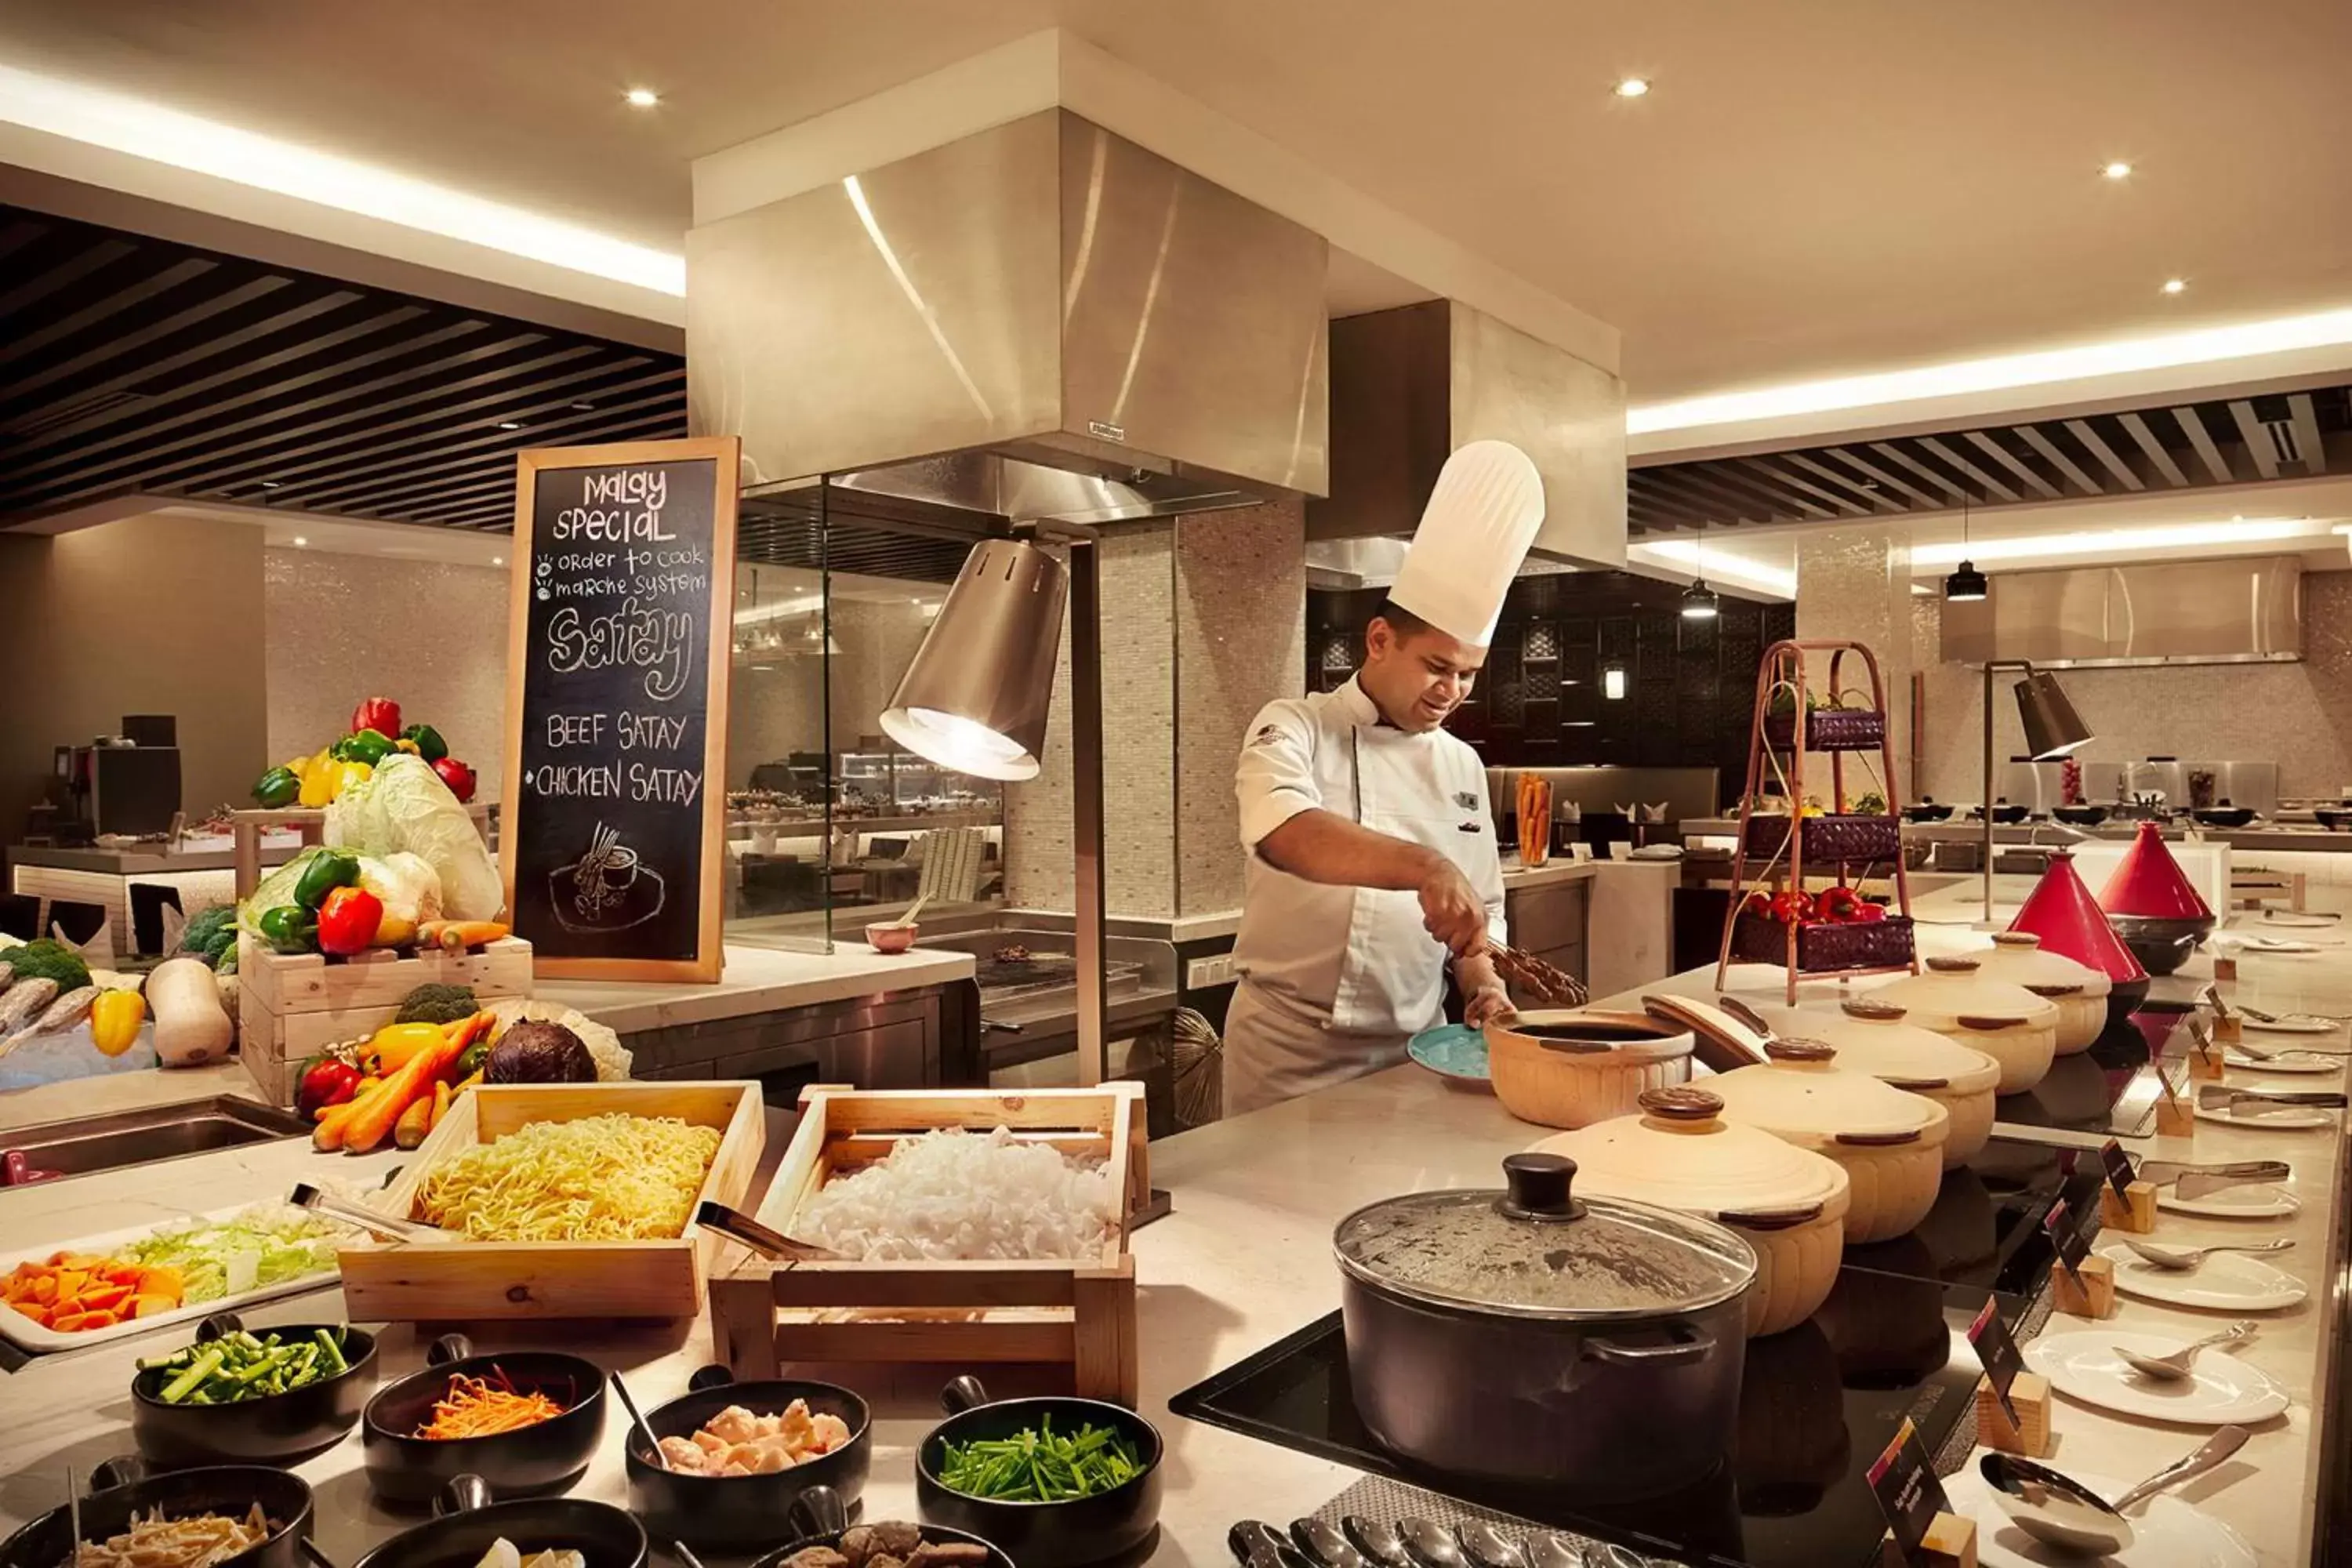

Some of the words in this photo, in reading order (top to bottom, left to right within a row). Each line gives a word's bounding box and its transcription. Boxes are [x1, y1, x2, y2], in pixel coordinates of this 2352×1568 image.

[624, 548, 652, 575] to
[657, 543, 704, 567] cook
[633, 571, 706, 601] system
[548, 714, 608, 747] BEEF
[618, 711, 688, 750] SATAY
[536, 759, 621, 798] CHICKEN
[630, 763, 703, 807] SATAY
